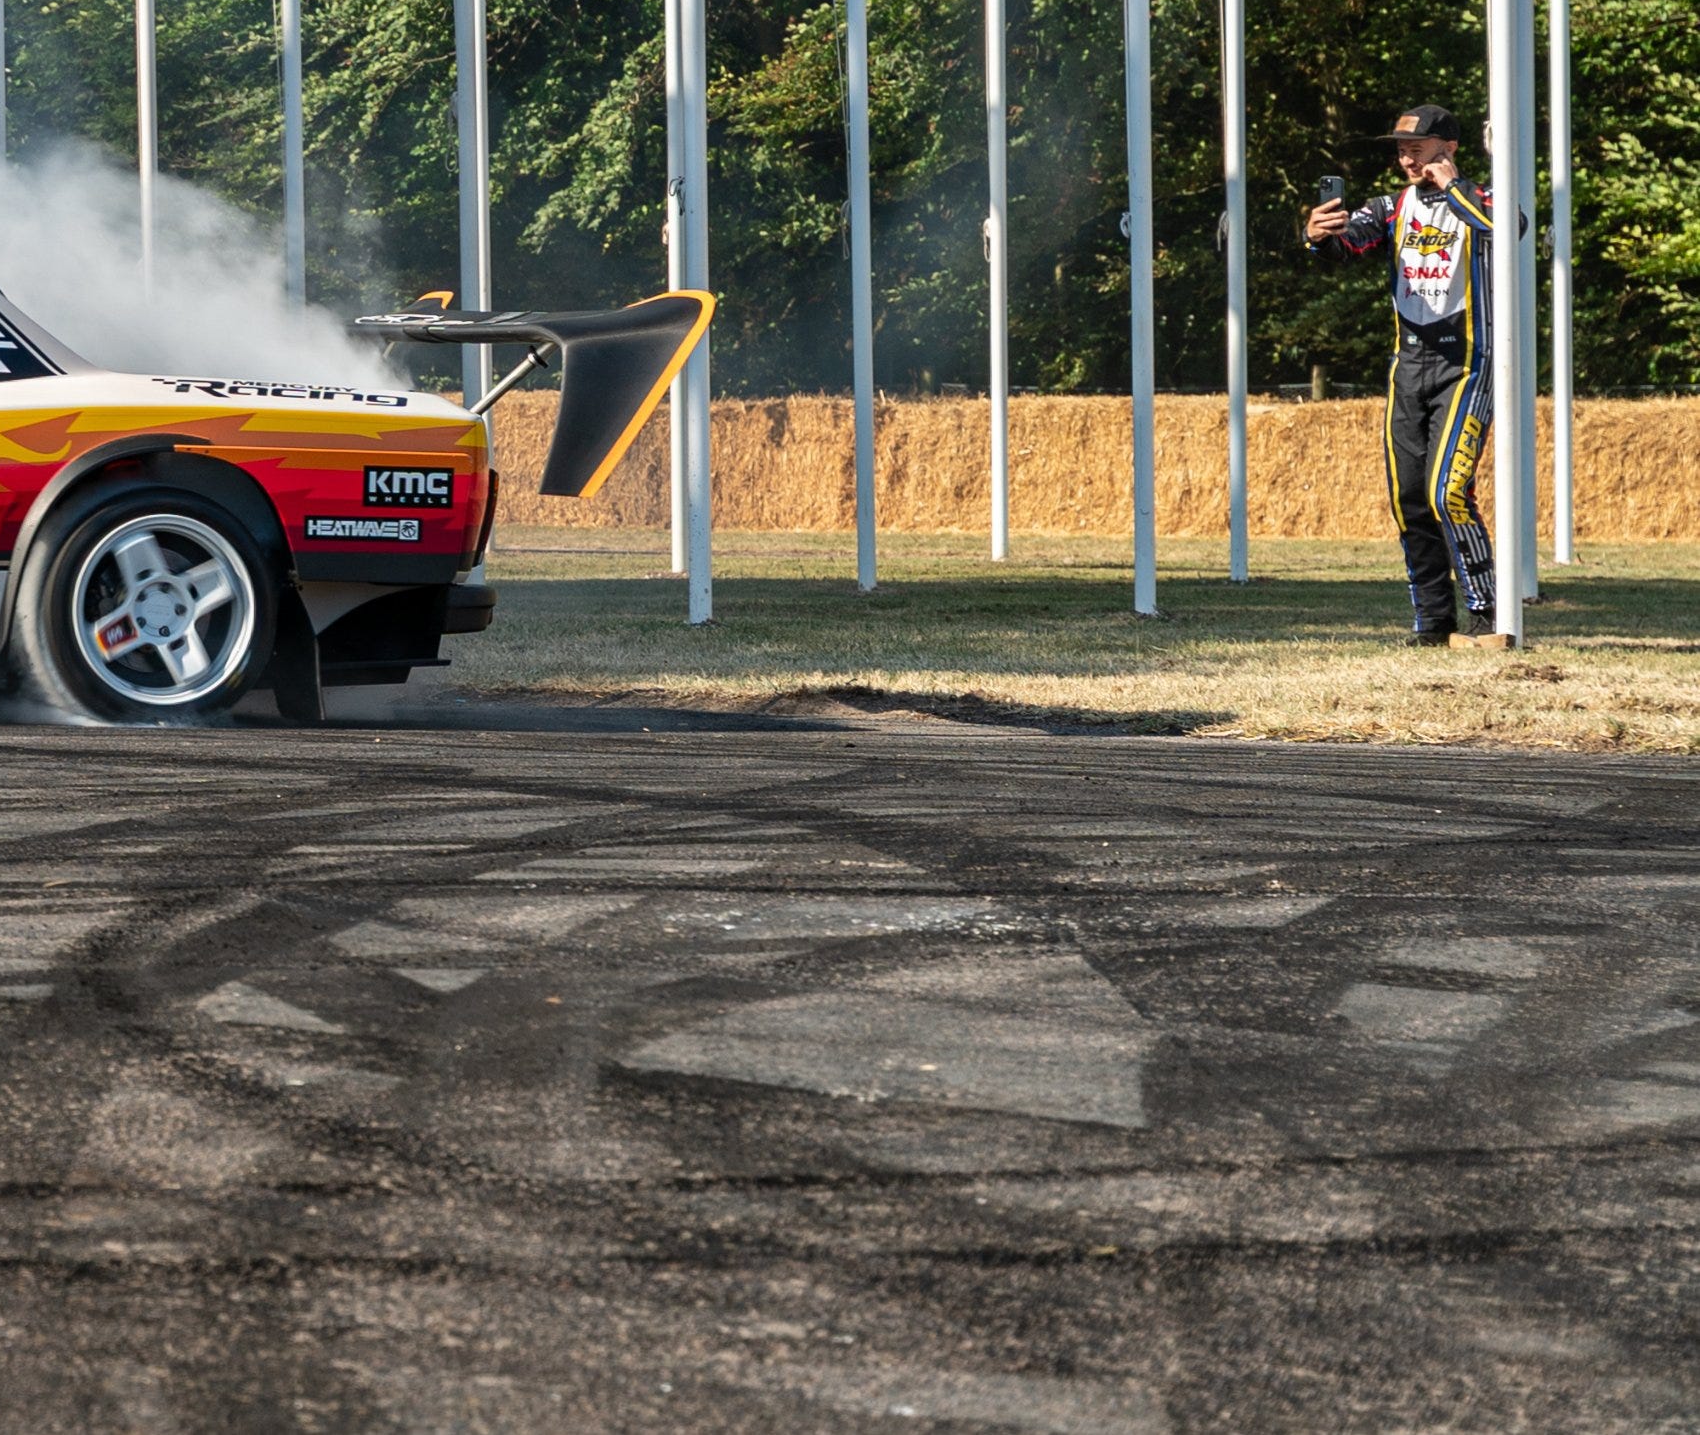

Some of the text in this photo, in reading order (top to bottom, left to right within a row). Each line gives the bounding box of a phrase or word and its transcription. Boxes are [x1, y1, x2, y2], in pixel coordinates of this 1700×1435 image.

[1438, 335, 1457, 343] AXEL
[232, 380, 357, 392] MERCURY
[368, 496, 448, 504] WHEELS
[307, 519, 399, 538] HEATWAVE
